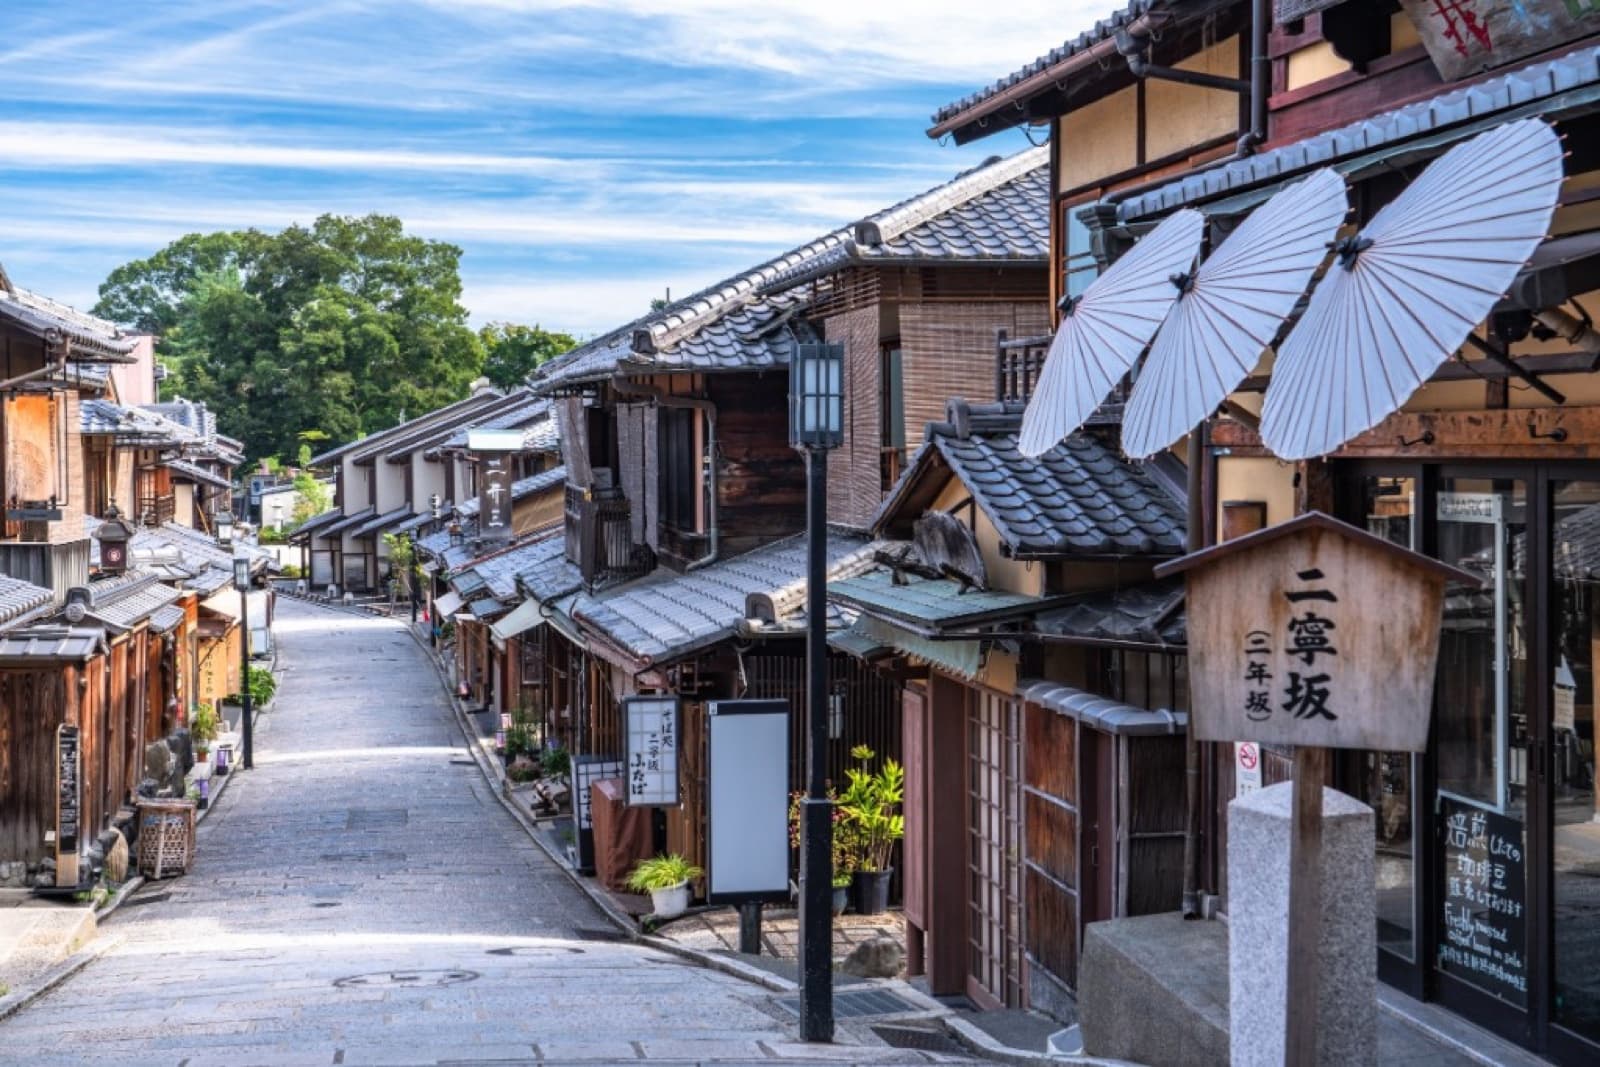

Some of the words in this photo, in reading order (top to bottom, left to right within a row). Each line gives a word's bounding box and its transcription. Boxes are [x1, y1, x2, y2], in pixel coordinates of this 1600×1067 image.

[1244, 629, 1273, 722] （二年坂）
[1281, 568, 1338, 722] 二寧坂
[630, 752, 648, 796] ふたば
[1457, 853, 1508, 890] 珈琲豆
